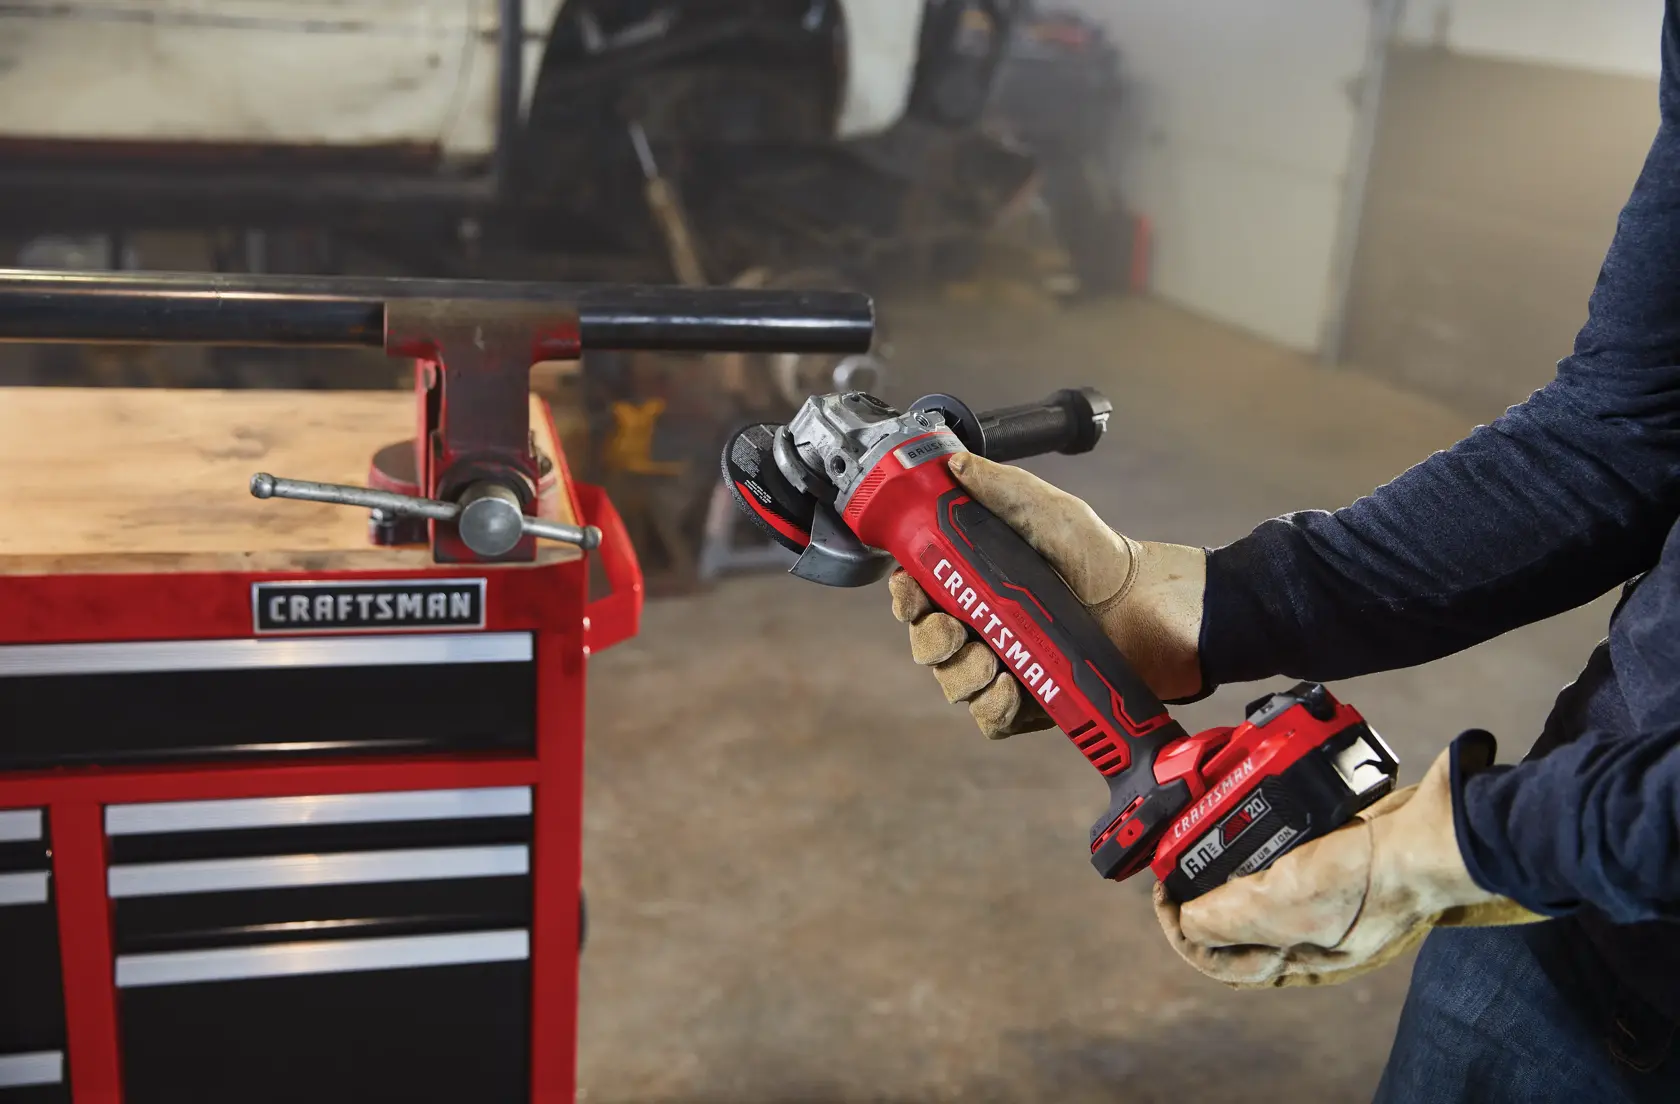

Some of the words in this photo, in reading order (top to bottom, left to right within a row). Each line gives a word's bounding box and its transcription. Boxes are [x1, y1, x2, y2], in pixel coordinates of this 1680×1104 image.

[269, 592, 472, 622] CRAFTSMAN
[933, 558, 1061, 704] CRAFTSMAN
[1173, 757, 1255, 839] CRAFTSMAN
